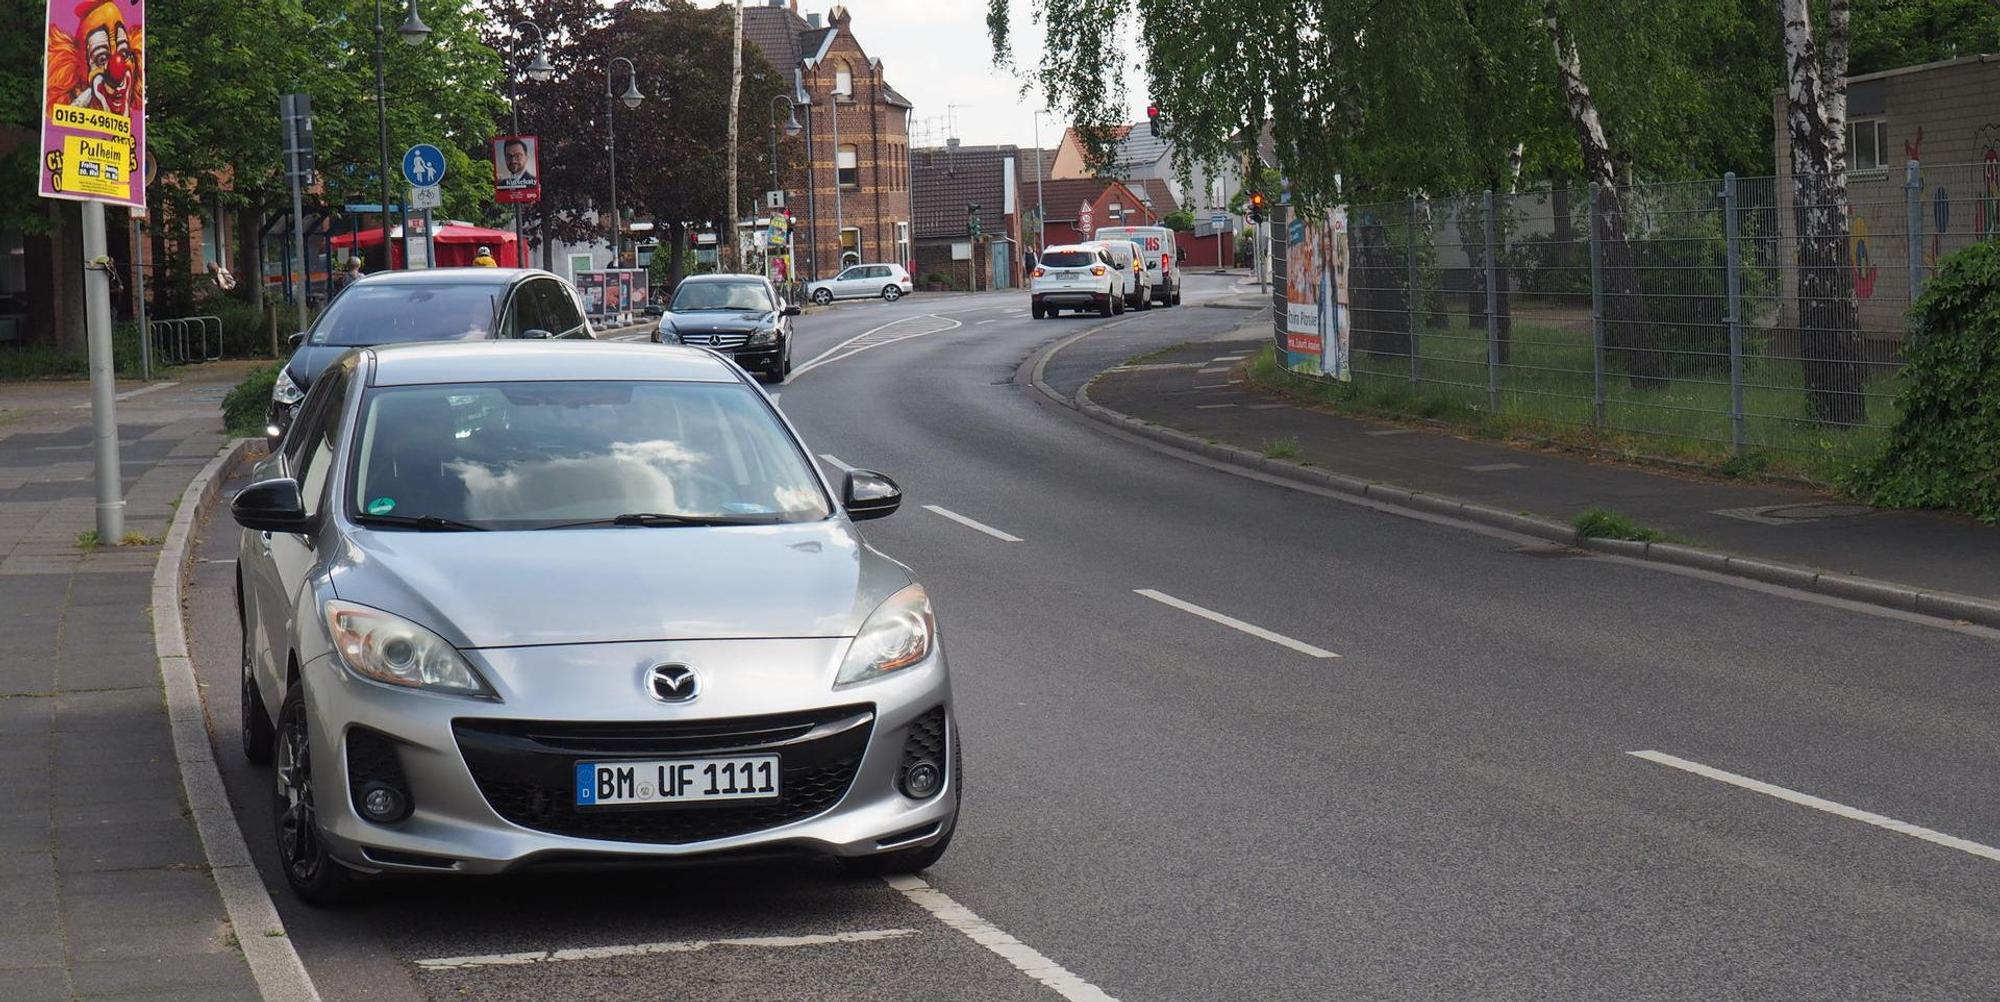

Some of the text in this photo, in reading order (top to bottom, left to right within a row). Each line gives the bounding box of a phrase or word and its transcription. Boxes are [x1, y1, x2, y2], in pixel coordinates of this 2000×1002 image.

[55, 109, 129, 133] 0163-4961765
[80, 140, 121, 160] Pulheim
[597, 761, 775, 799] BM UF 1111
[582, 788, 590, 798] D
